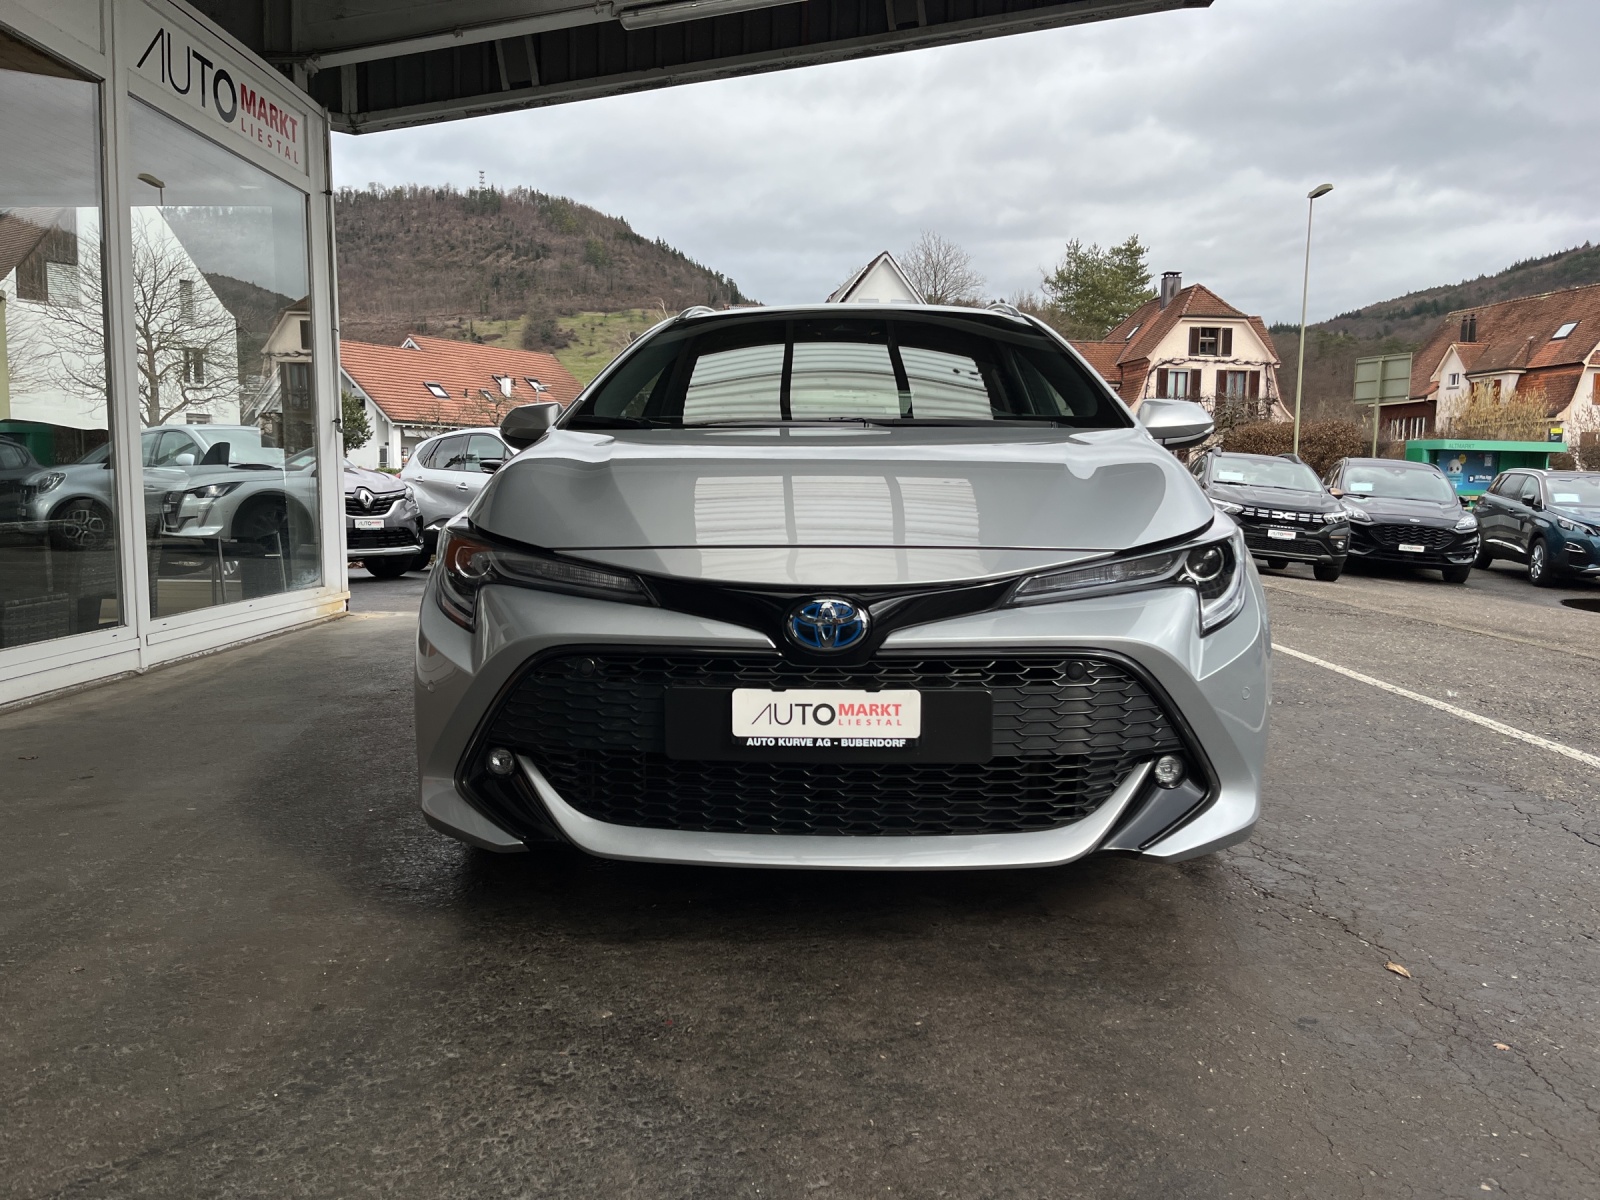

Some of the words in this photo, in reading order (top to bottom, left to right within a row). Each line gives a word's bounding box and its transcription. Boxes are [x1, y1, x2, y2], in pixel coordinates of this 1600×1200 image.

[136, 28, 237, 123] AUTO
[240, 83, 298, 143] MARKT
[241, 117, 299, 164] LIESTAL
[752, 703, 836, 726] AUTO
[838, 703, 902, 716] MARKT
[746, 738, 775, 747] AUTO
[778, 738, 814, 747] KURVE
[816, 738, 831, 747] AG
[841, 738, 906, 747] BUBENDORF
